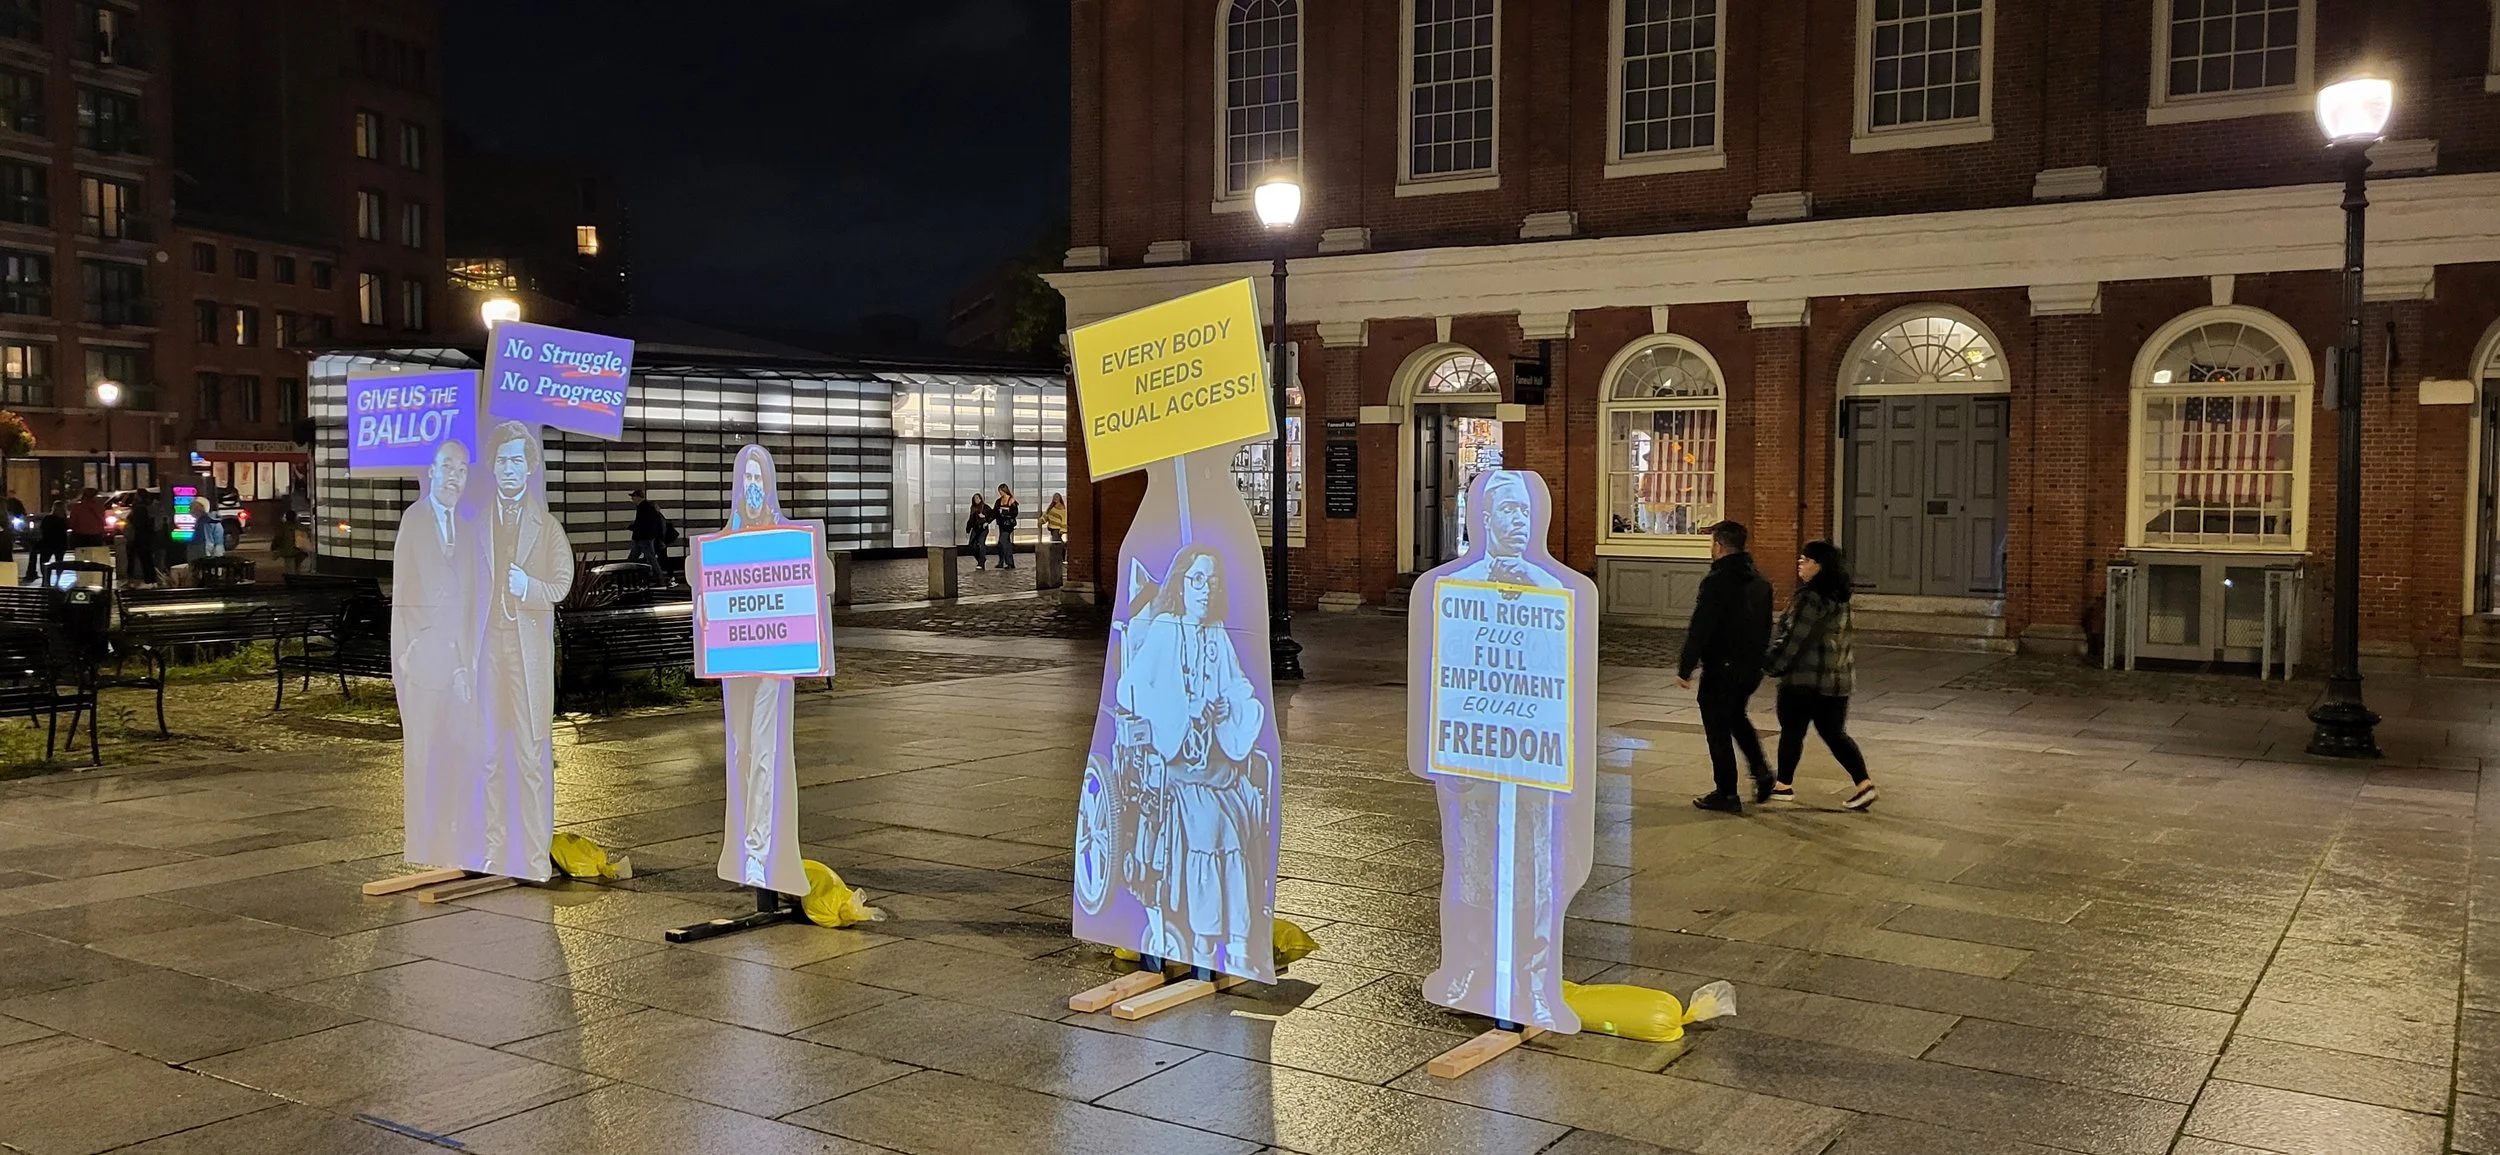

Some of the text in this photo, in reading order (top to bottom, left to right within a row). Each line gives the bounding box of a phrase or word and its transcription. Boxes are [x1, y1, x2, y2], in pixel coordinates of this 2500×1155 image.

[503, 338, 628, 377] No Struggle,
[1101, 317, 1231, 375] EVERY BODY
[499, 371, 624, 406] No Progress
[1134, 358, 1203, 395] NEEDS
[357, 384, 458, 411] GIVE US THE
[1093, 372, 1257, 437] EQUAL ACCESS!
[357, 408, 460, 447] BALLOT
[704, 563, 812, 587] TRANSGENDER
[728, 594, 785, 613] PEOPLE
[1441, 597, 1566, 631] CIVIL RIGHTS
[729, 622, 788, 642] BELONG
[1474, 626, 1524, 646] PLUS
[1474, 645, 1527, 671] FULL
[1440, 666, 1565, 700] EMPLOYMENT
[1462, 696, 1538, 719] EQUALS
[1438, 719, 1564, 767] FREEDOM
